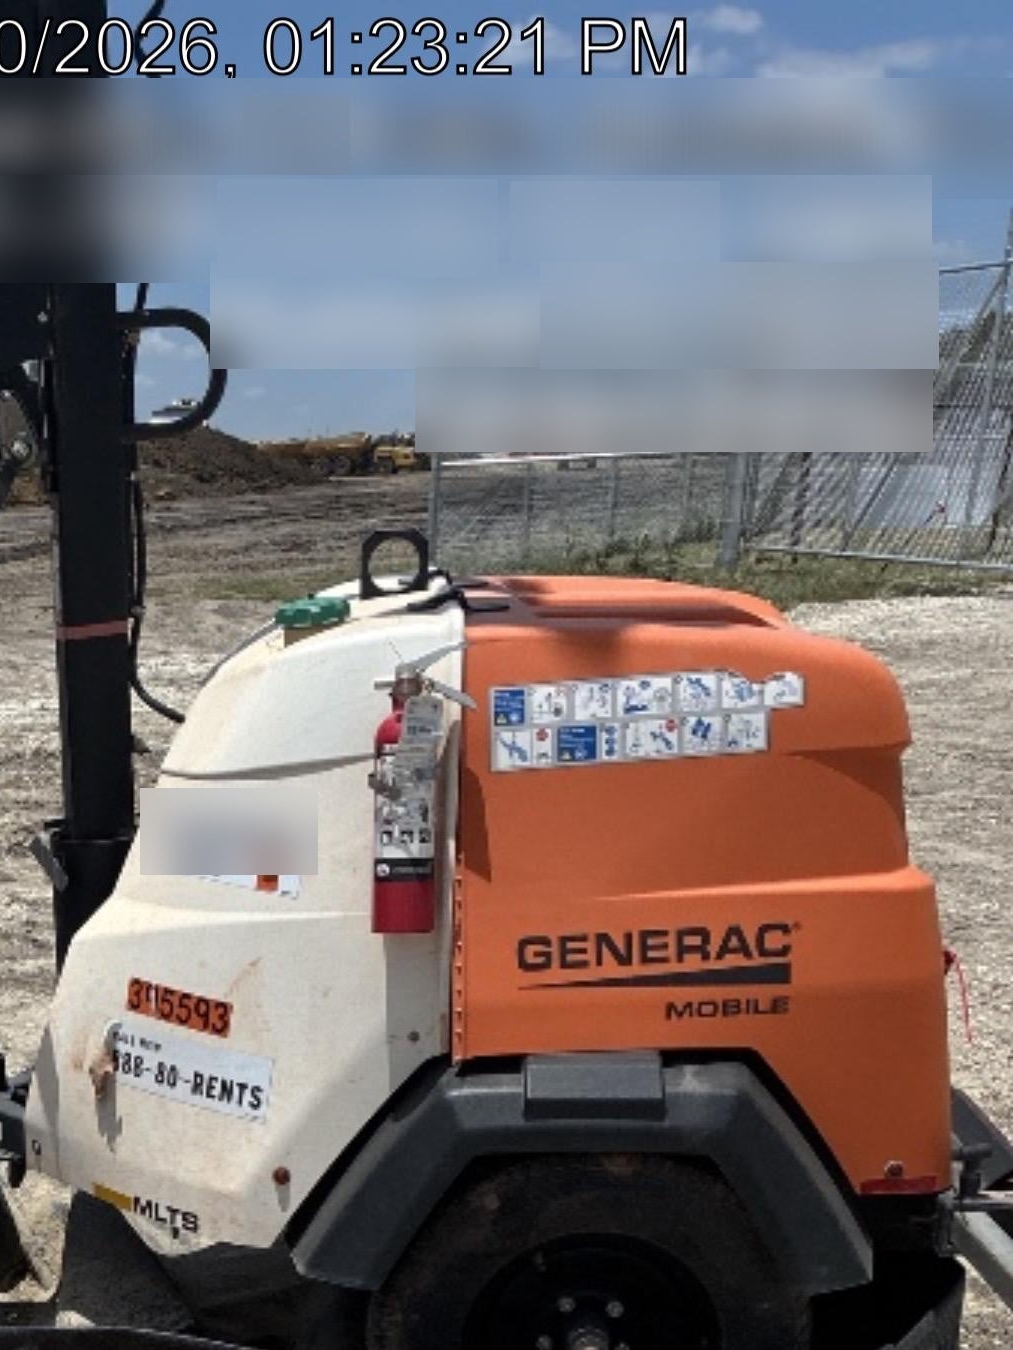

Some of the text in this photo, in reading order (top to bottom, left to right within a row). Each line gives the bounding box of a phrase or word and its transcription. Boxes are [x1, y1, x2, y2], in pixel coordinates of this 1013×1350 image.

[517, 922, 792, 972] GENERAC
[665, 996, 790, 1021] MOBILE
[133, 1196, 199, 1234] MLTS
